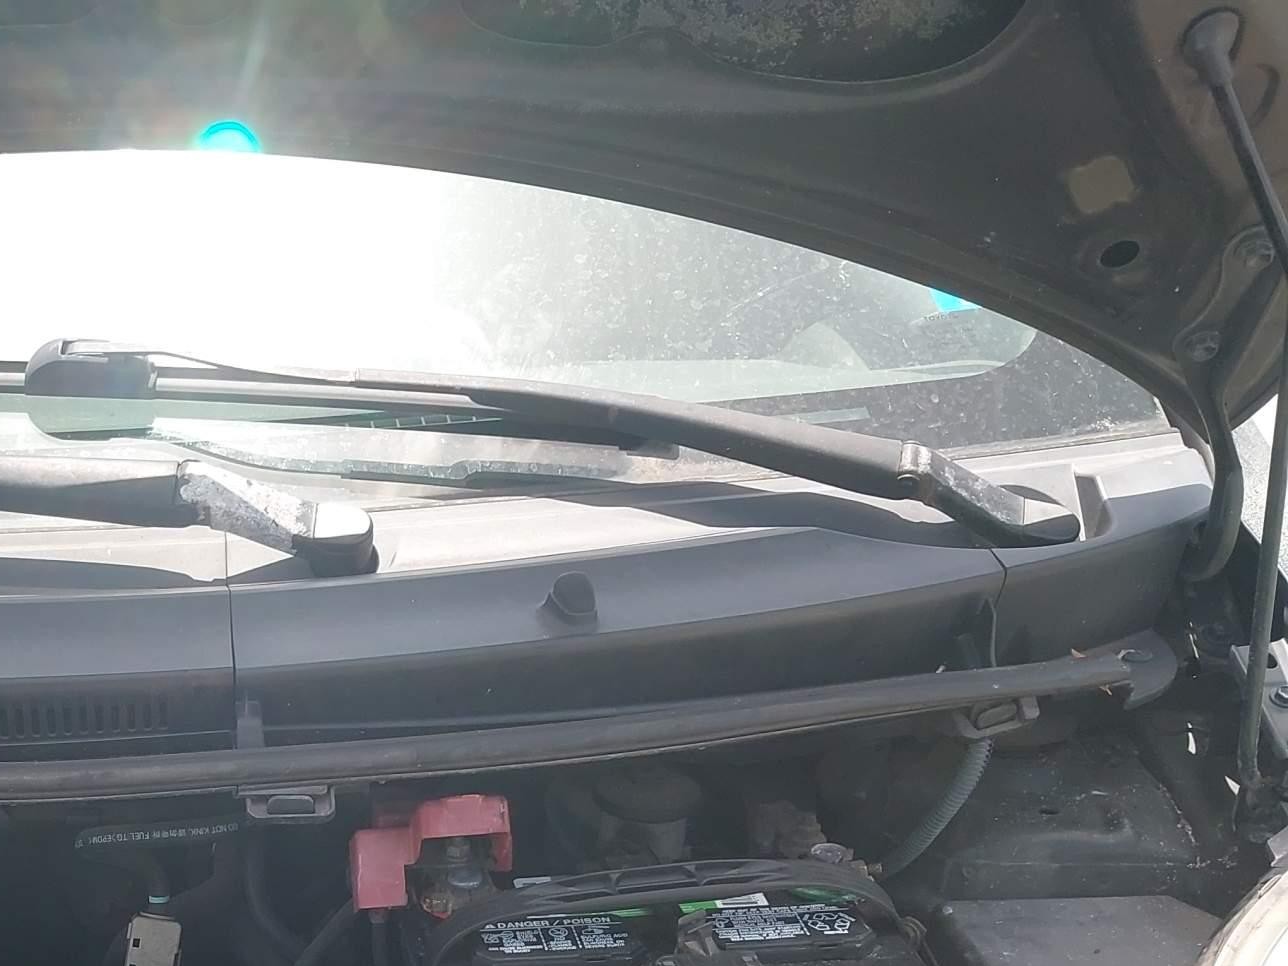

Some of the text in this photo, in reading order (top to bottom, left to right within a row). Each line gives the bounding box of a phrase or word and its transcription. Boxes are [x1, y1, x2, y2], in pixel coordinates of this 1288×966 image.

[129, 830, 150, 841] FUEL
[497, 920, 550, 929] DANGER
[563, 916, 611, 925] POISON
